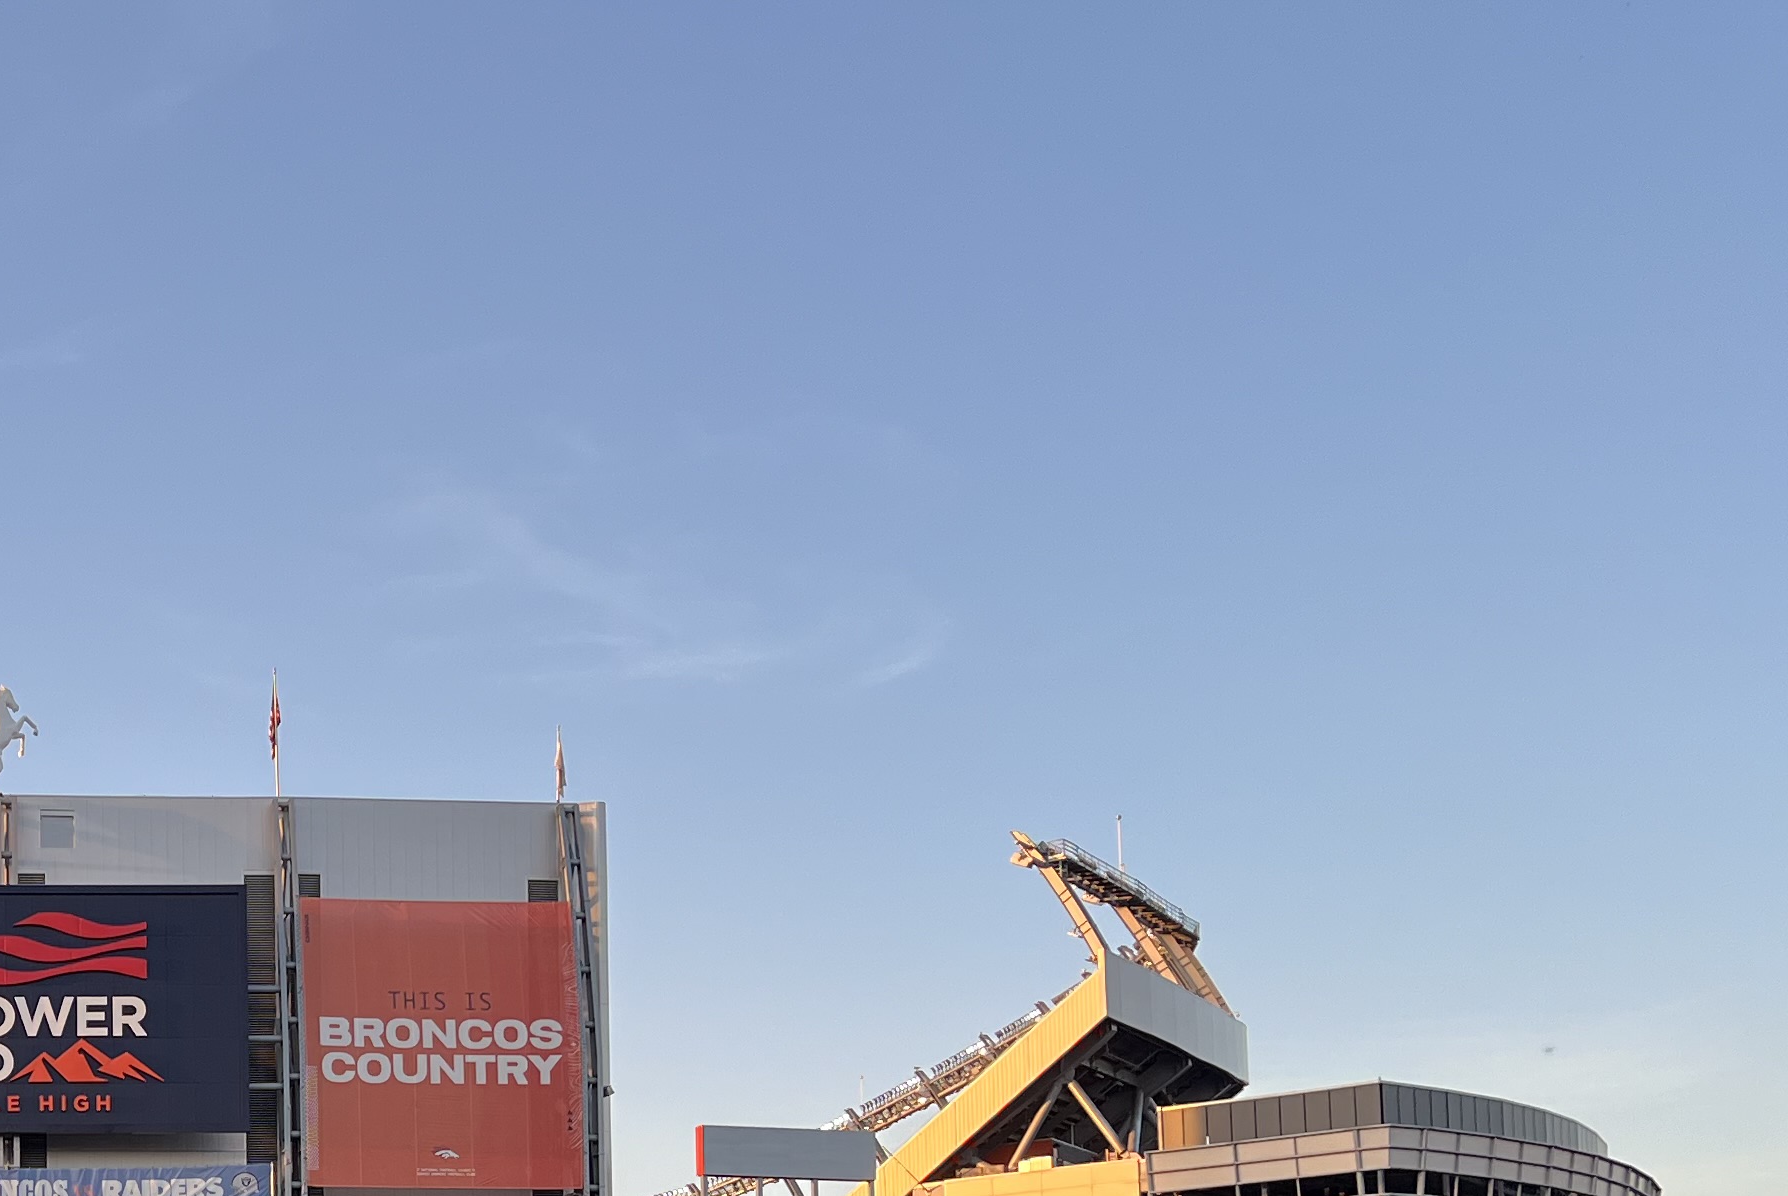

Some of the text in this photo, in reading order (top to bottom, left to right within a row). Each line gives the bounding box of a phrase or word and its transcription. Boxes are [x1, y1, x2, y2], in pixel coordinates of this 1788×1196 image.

[388, 990, 491, 1010] THIS IS
[319, 1016, 563, 1050] BRONCOS
[321, 1052, 563, 1085] COUNTRY
[39, 1094, 112, 1112] HIGH
